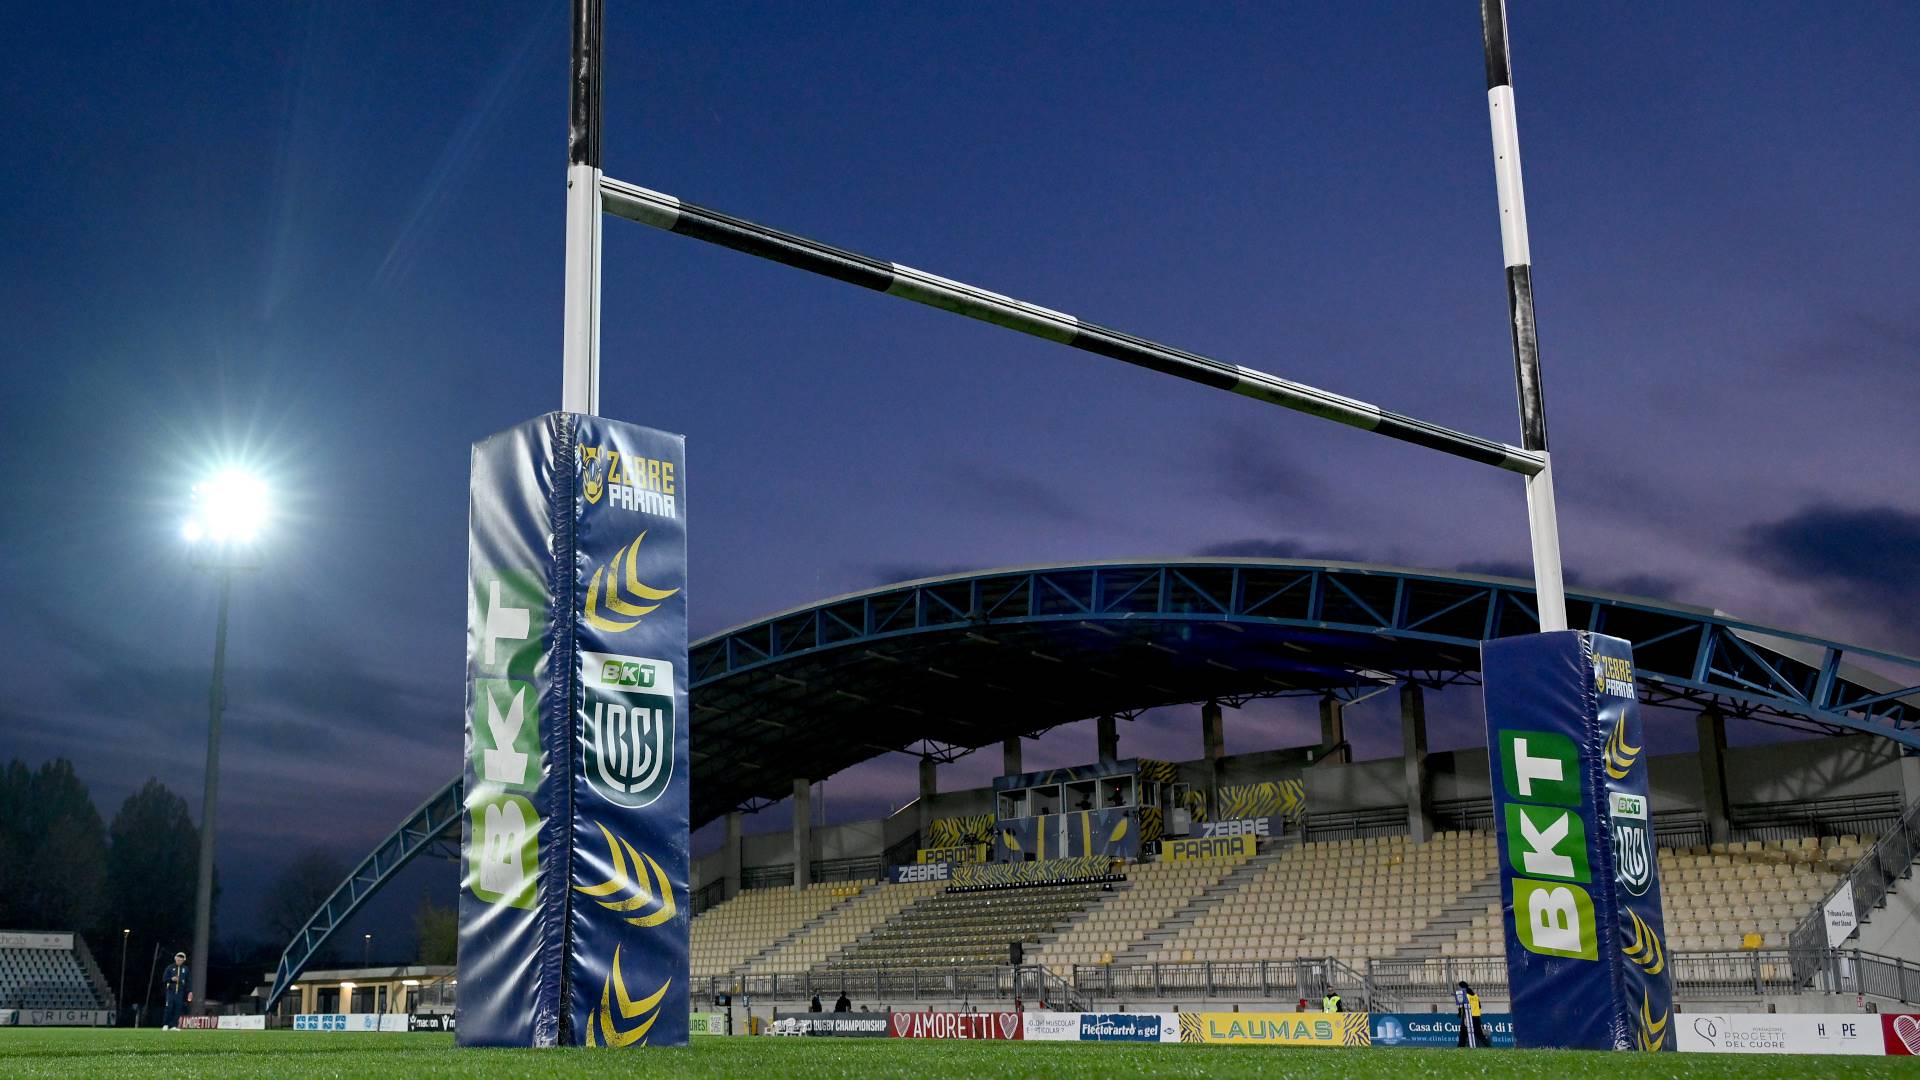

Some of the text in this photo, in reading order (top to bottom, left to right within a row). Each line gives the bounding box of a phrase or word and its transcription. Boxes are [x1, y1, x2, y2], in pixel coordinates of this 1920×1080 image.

[607, 450, 675, 494] ZEBRE
[608, 484, 675, 519] PARMA
[603, 664, 655, 687] BKT
[1602, 655, 1633, 683] ZEBRE
[1606, 679, 1635, 699] PARMA
[480, 580, 530, 898] BKT
[1618, 798, 1640, 815] BKT
[1203, 817, 1269, 838] ZEBRE
[925, 847, 977, 864] PARMA
[1173, 836, 1244, 860] PARMA
[1513, 737, 1583, 953] BKT
[898, 862, 948, 883] ZEBRE
[813, 1019, 834, 1032] RUGBY
[835, 1019, 887, 1032] CHAMPIONSHIP
[913, 1013, 995, 1039] AMORETTI
[1144, 1025, 1158, 1038] gel
[1209, 1020, 1333, 1040] LAUMAS
[1408, 1022, 1430, 1032] Casa
[1432, 1022, 1442, 1032] di
[1445, 1022, 1461, 1032] Cur
[1495, 1022, 1505, 1033] di
[1724, 1031, 1786, 1041] PROGETTI
